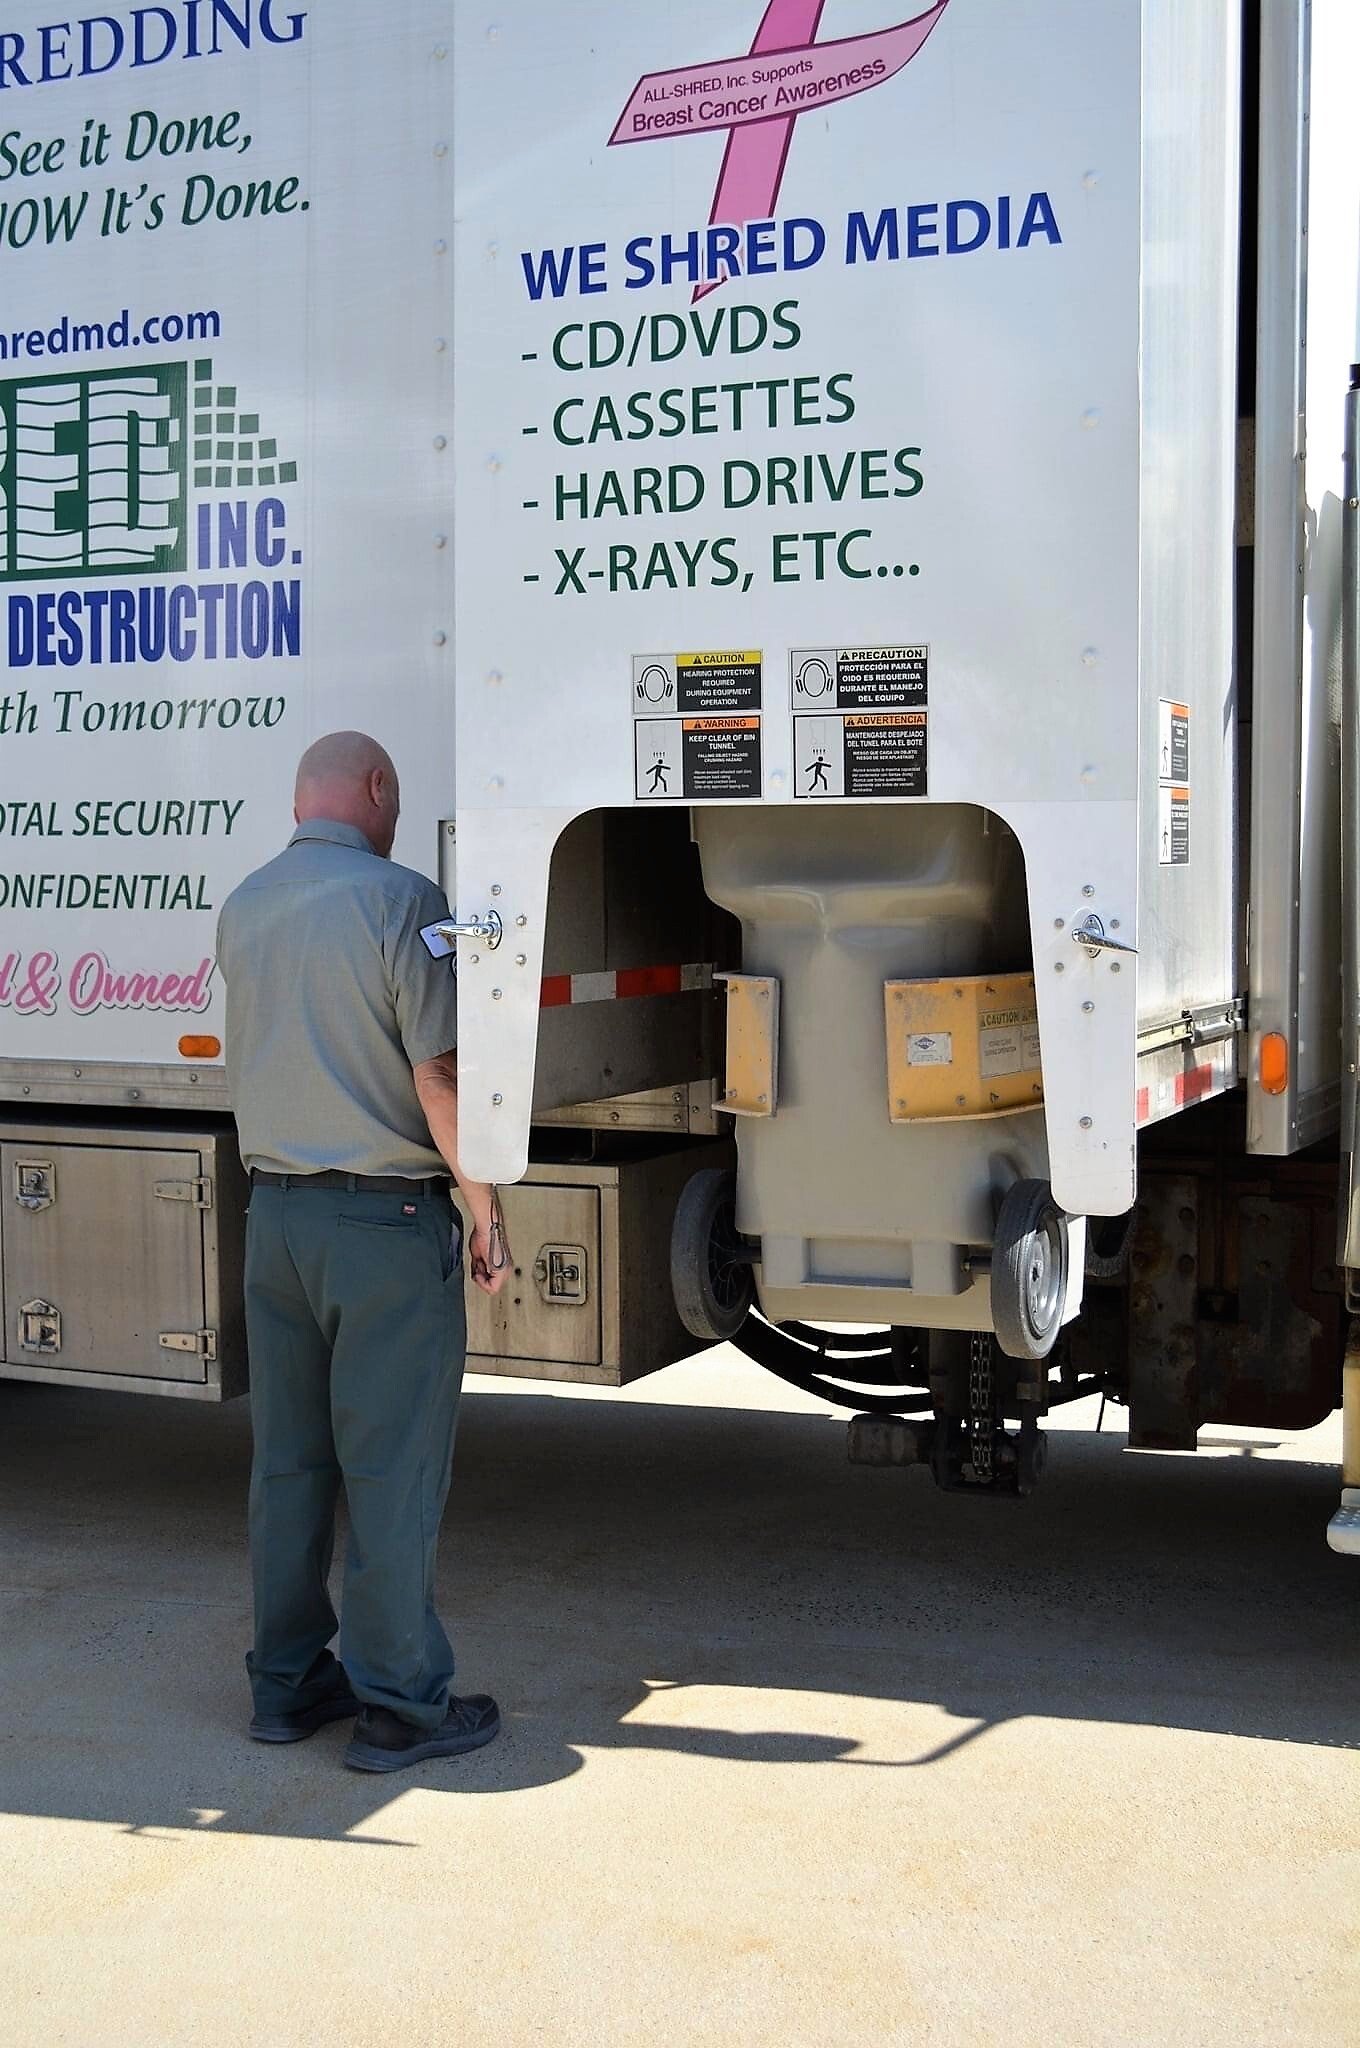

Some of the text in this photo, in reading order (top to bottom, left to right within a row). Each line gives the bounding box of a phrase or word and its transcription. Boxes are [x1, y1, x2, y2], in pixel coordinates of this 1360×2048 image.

[633, 58, 887, 132] Breast Cancer Awareness
[643, 59, 813, 104] ALL-SHRED, Inc. Supports
[0, 110, 252, 181] See it Done,
[100, 183, 166, 237] It's
[181, 174, 310, 226] Done.
[521, 192, 1062, 300] WE SHRED MEDIA
[552, 300, 801, 371] CD/DVDS
[553, 373, 855, 446] CASSETTES
[0, 376, 180, 572] ED
[555, 464, 705, 521] HARD
[723, 447, 924, 509] DRIVES
[197, 497, 302, 570] INC.
[554, 537, 754, 595] X-RAYS,
[772, 529, 920, 582] ETC...
[7, 579, 301, 667] DESTRUCTION
[703, 654, 745, 664] CAUTION
[713, 669, 755, 677] PROTECTION
[851, 649, 922, 660] PRECAUTION
[891, 663, 912, 671] PARA
[686, 688, 752, 697] DURING EQUIPMENT
[702, 679, 735, 687] REQUIRED
[840, 684, 877, 692] DURANTE
[890, 683, 923, 691] MANEJO
[863, 674, 874, 682] ES
[875, 673, 921, 681] REQUERIDA
[53, 690, 286, 733] Tomorrow
[700, 698, 738, 706] OPERATION
[875, 694, 905, 702] EQUIPO
[704, 719, 747, 728] WARNING
[856, 715, 923, 725] ADVERTENCIA
[888, 730, 924, 738] DESPEJADO
[0, 800, 245, 837] TAL SECURITY
[69, 951, 212, 1009] Owned
